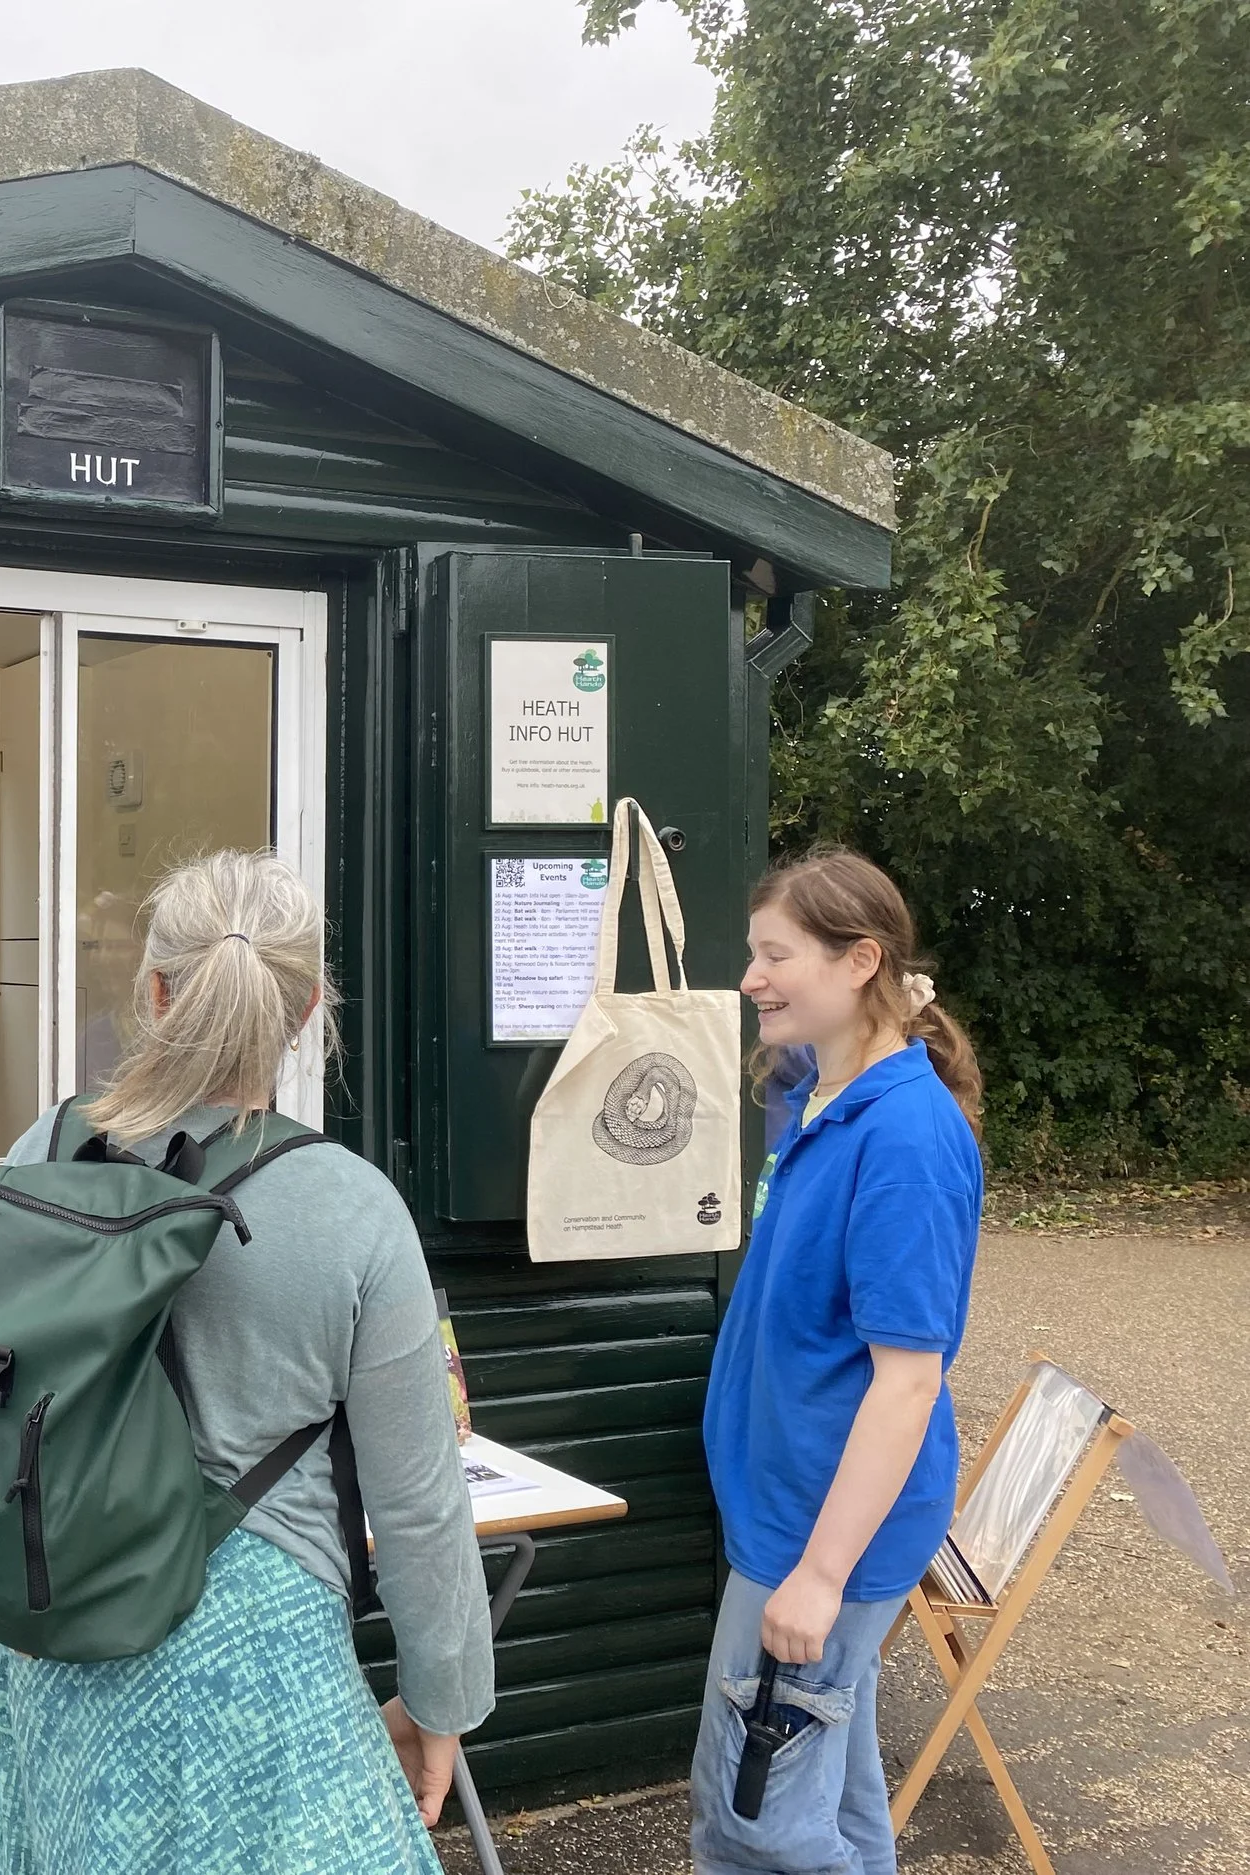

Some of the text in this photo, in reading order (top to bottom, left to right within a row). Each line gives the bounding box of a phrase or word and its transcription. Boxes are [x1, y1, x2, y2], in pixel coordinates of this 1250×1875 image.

[70, 453, 140, 486] HUT
[523, 700, 579, 716] HEATH
[510, 726, 594, 742] INFO HUT
[533, 862, 573, 871] Upcoming
[614, 1214, 646, 1222] Community
[572, 1224, 604, 1232] Hampstead
